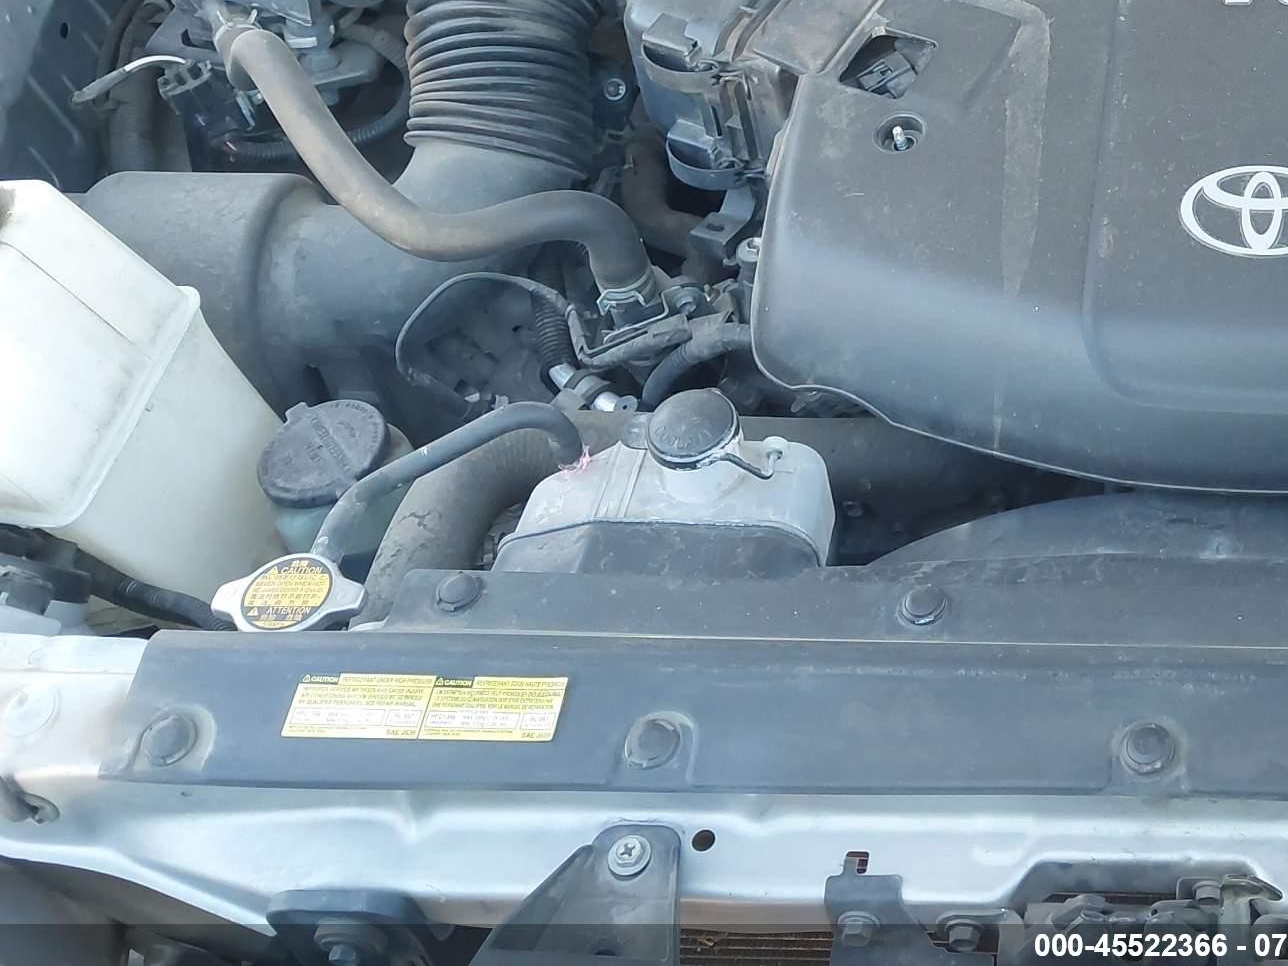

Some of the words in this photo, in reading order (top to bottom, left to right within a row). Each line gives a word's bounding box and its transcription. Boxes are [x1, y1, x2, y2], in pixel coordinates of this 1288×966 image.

[280, 566, 323, 575] CAUTION
[266, 606, 312, 615] ATTENTION
[310, 674, 339, 683] CAUTION
[444, 679, 473, 687] CAUTION
